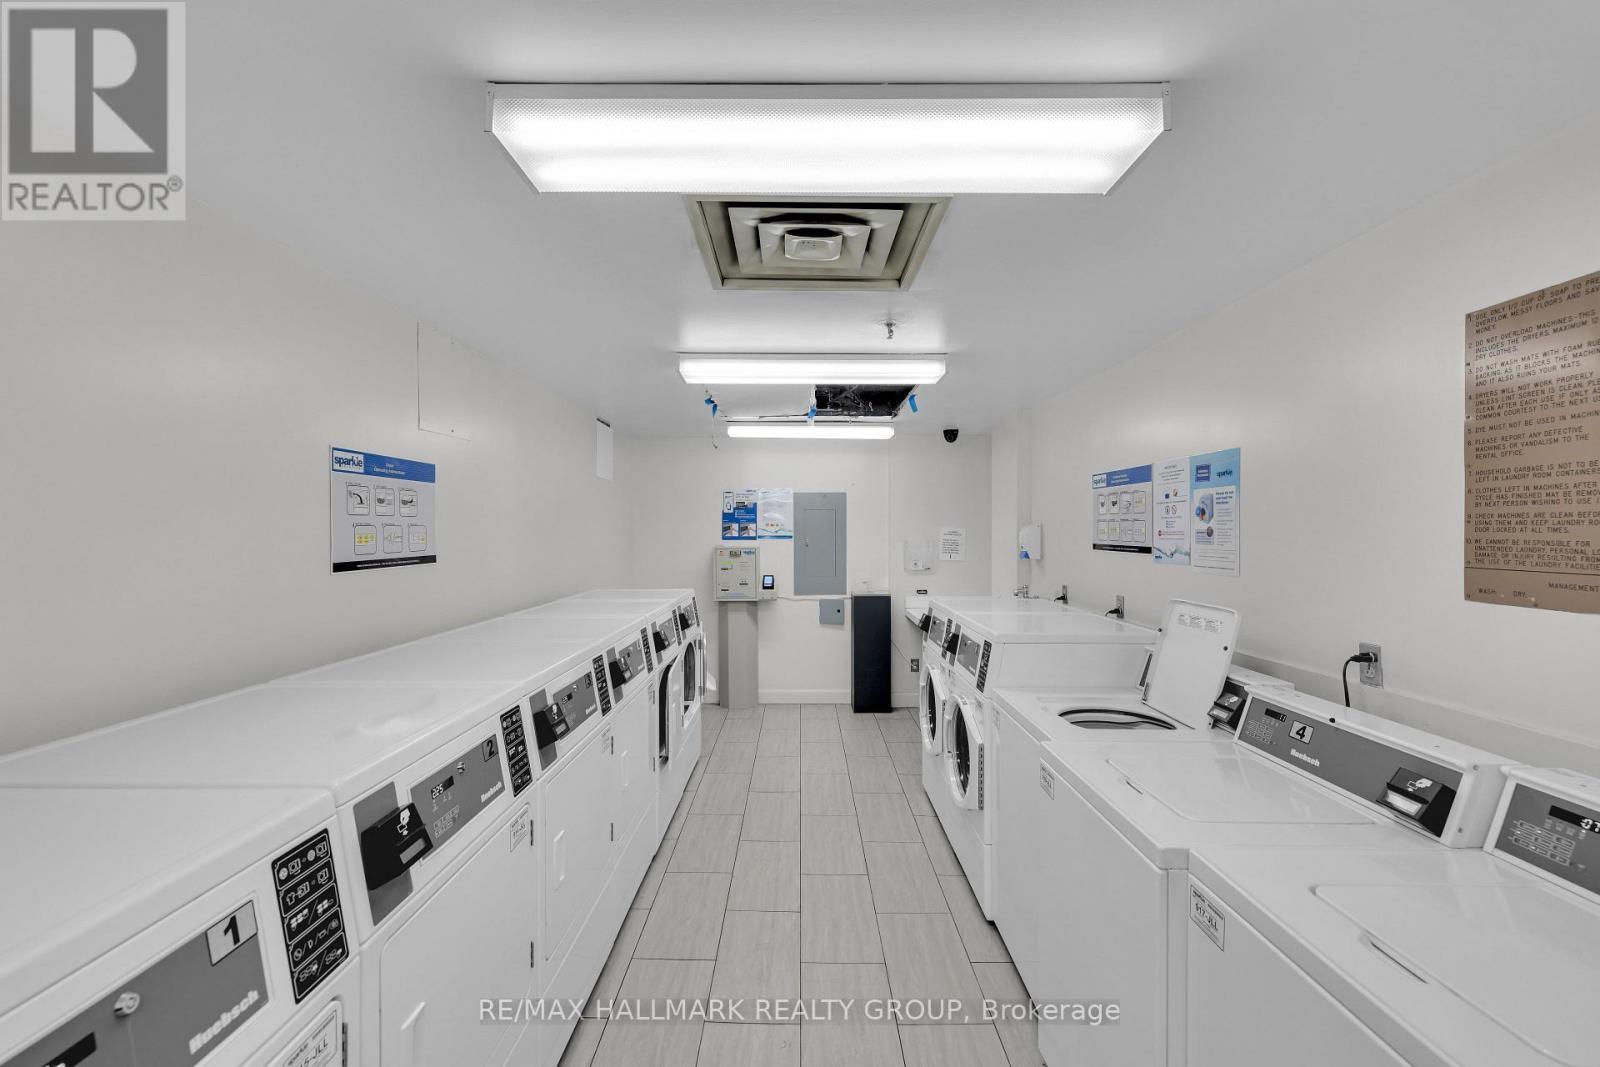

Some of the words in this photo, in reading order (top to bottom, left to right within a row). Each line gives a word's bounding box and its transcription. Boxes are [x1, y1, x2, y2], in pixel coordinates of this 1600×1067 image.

[1510, 306, 1532, 317] MESSY
[1566, 291, 1581, 300] AND
[1500, 326, 1532, 340] OVERLOAD
[1552, 319, 1587, 334] MAXIMUM
[1500, 358, 1518, 367] WASH
[1521, 353, 1540, 362] MATS
[1562, 343, 1582, 352] FOAM
[1524, 359, 1550, 369] BLOCKS
[1475, 390, 1497, 399] DRYERS
[1533, 380, 1551, 388] WORK
[1556, 371, 1593, 383] PROPERLY
[1475, 398, 1498, 407] UNLESS
[1518, 389, 1544, 399] SCREEN
[1475, 406, 1494, 414] CLEAN
[1497, 402, 1516, 410] AFTER
[1519, 398, 1537, 406] EACH
[1569, 389, 1587, 398] ONLY
[1475, 412, 1500, 421] COMMON
[1503, 406, 1536, 416] COURTESY
[1568, 397, 1587, 406] NEXT
[1543, 426, 1583, 436] DEFECTIVE
[1520, 438, 1558, 447] VANDALISM
[1296, 726, 1306, 739] 4
[487, 740, 494, 757] 2
[223, 914, 241, 946] 1
